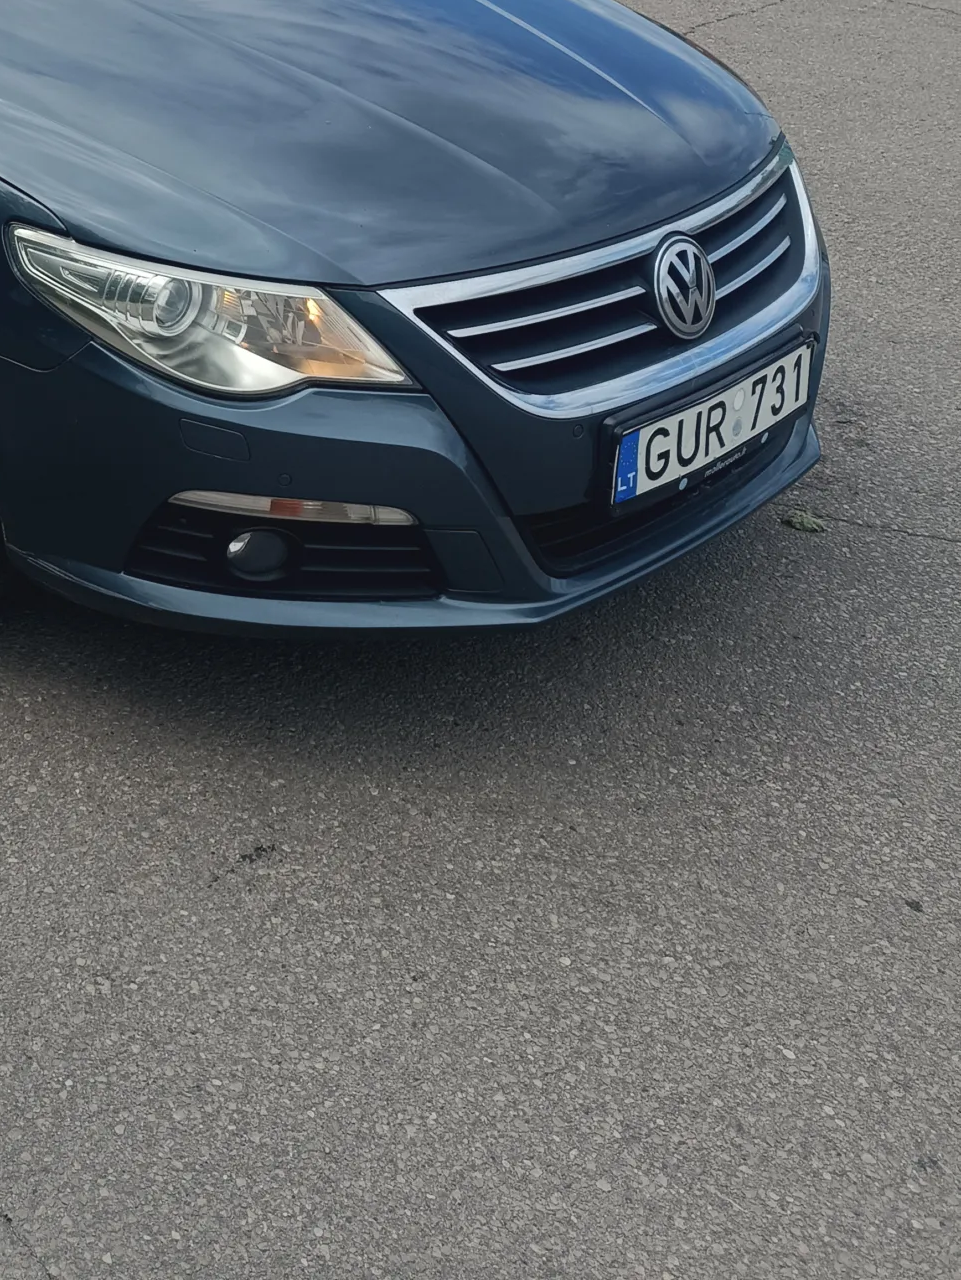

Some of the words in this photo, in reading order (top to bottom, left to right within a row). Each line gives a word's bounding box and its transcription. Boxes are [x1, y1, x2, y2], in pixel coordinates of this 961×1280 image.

[618, 471, 637, 491] LT
[645, 400, 727, 481] GUR
[750, 353, 803, 431] 731
